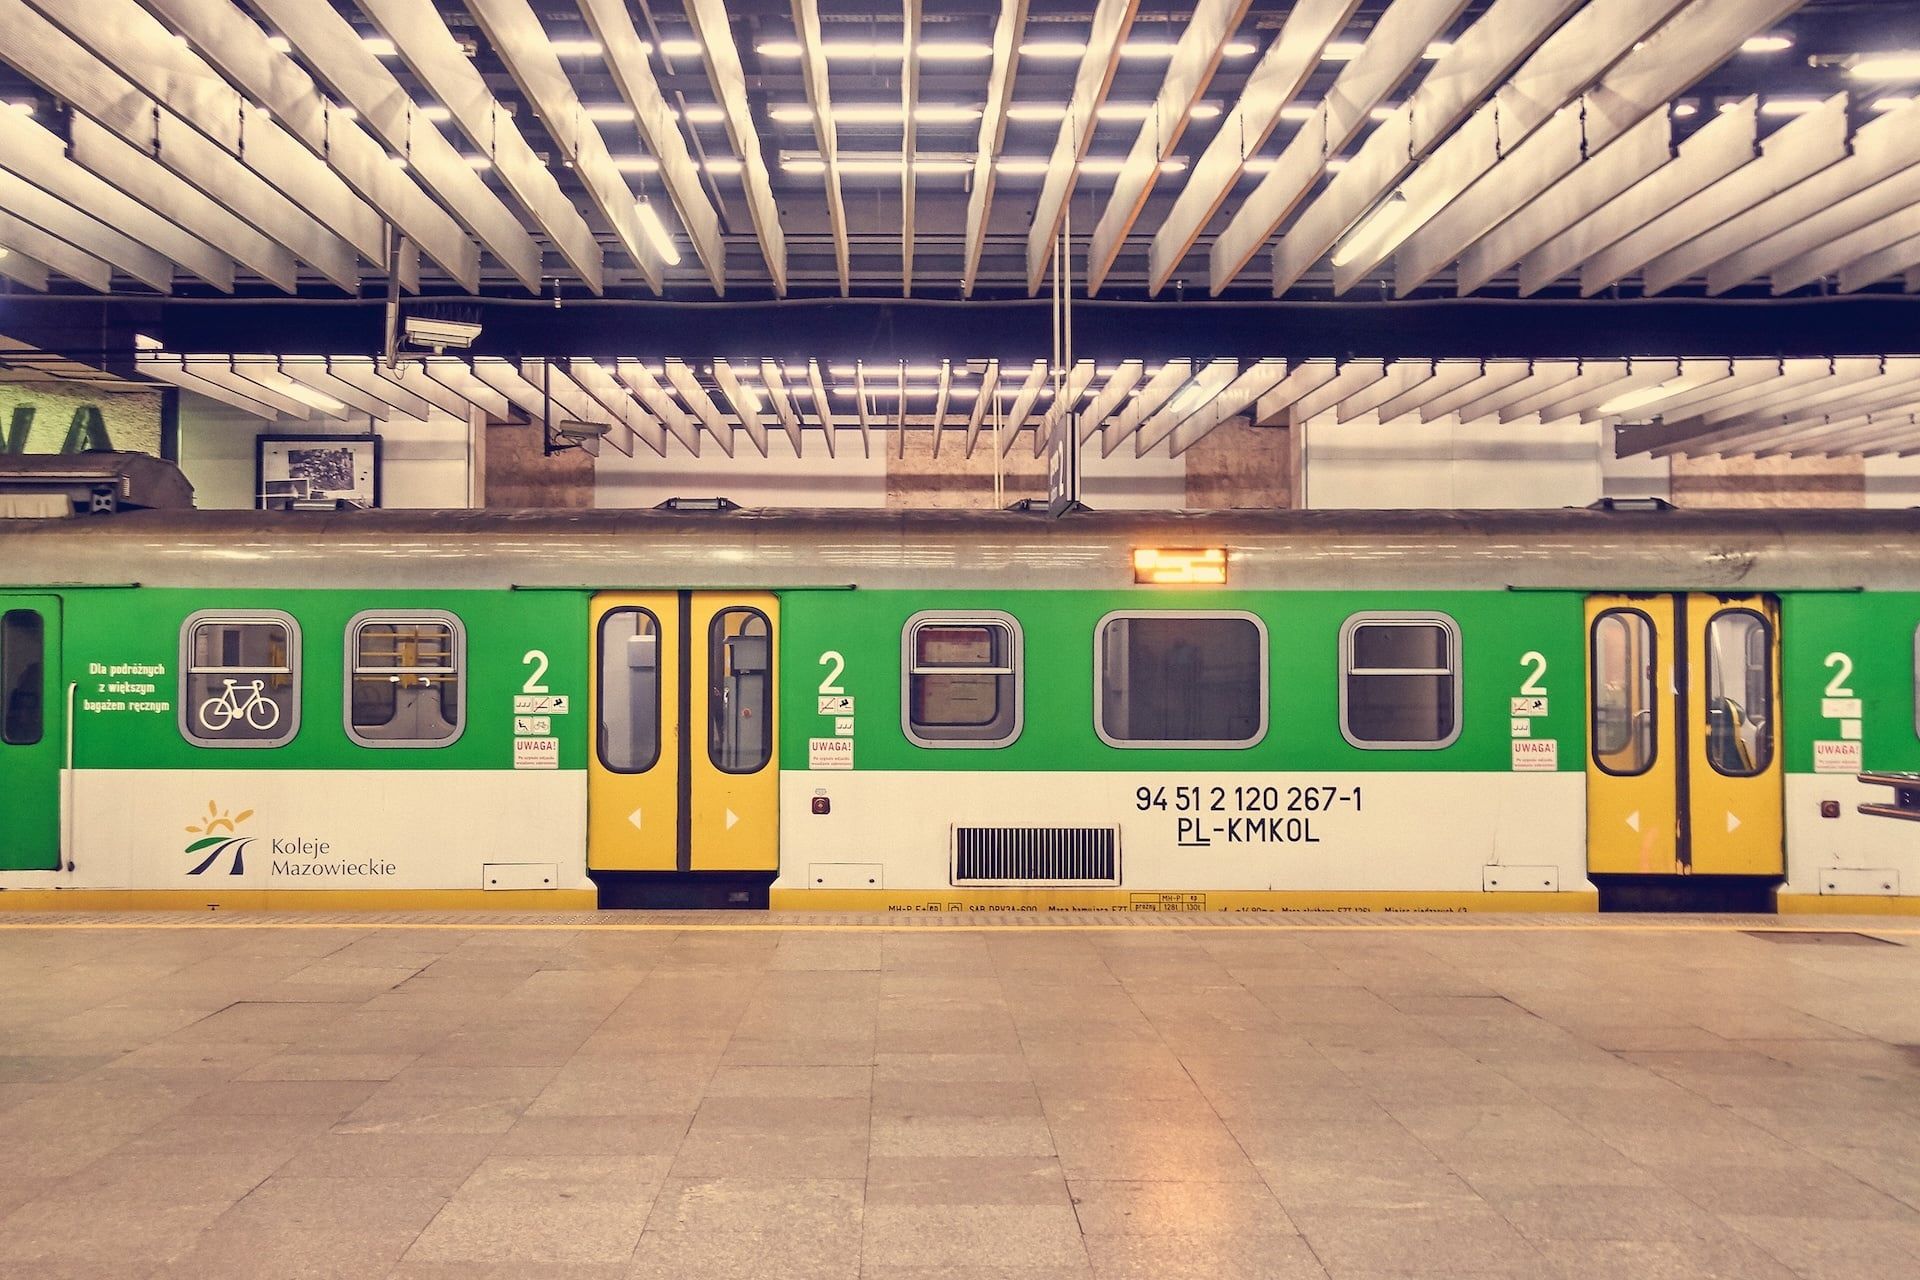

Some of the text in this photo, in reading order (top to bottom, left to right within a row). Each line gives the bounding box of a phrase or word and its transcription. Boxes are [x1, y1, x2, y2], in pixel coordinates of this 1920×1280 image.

[89, 662, 165, 677] Dla podróżnych
[522, 650, 549, 693] 2
[818, 651, 845, 694] 2
[1520, 651, 1547, 695] 2
[1824, 652, 1853, 697] 2
[98, 681, 155, 695] z większym
[83, 698, 170, 713] bagażem ręcznym
[517, 741, 556, 751] UWAGA!
[812, 742, 851, 751] UWAGA!
[1515, 743, 1554, 753] UWAGA!
[1817, 745, 1859, 754] UWAGA!
[1136, 786, 1362, 812] 94 51 2 120 267-1
[1178, 818, 1320, 843] PL-KMKOL
[272, 836, 330, 859] Koleje
[271, 858, 396, 876] Mazowieckie
